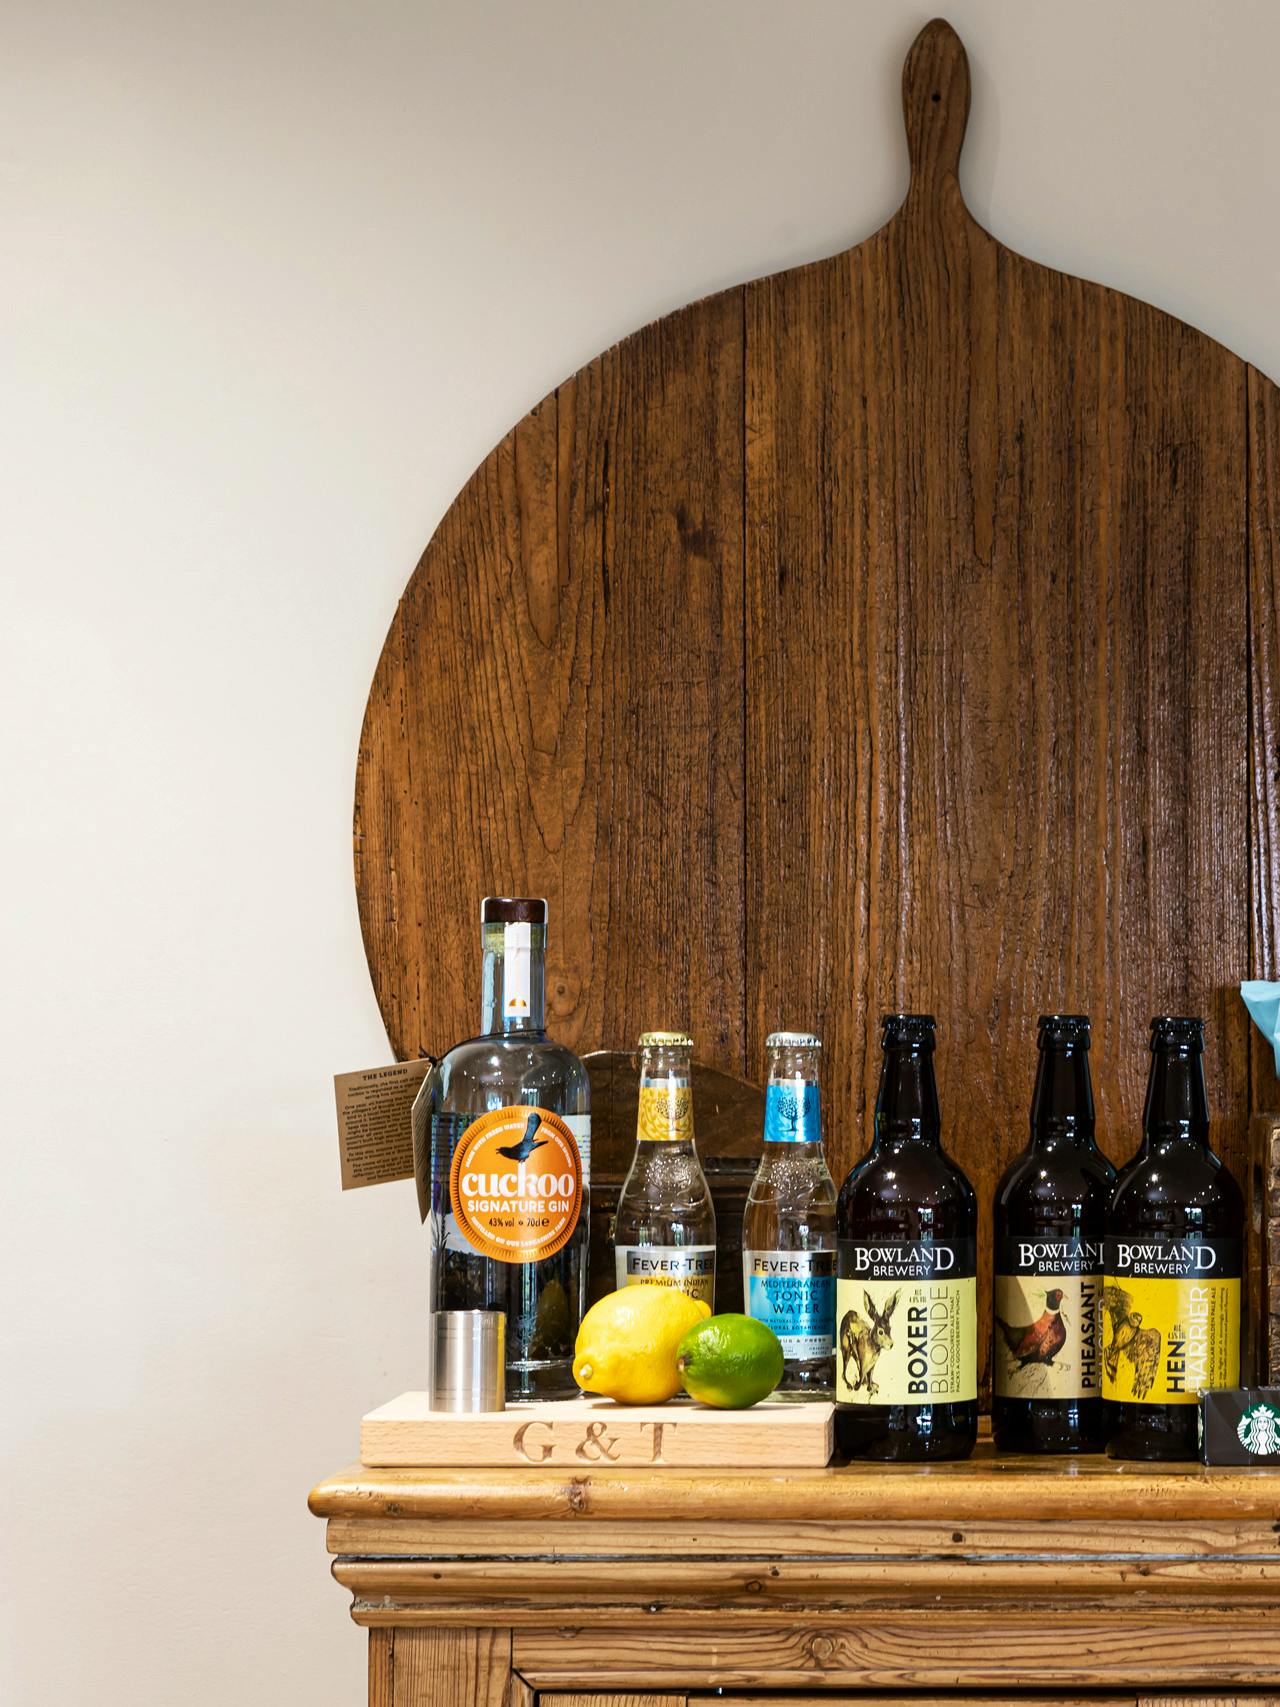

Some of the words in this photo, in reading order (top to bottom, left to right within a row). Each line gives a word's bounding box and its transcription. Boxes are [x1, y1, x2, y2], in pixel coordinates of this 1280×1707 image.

[362, 1073, 378, 1081] THE
[379, 1068, 408, 1079] LEGEND
[462, 1161, 575, 1198] cuckoo
[467, 1200, 545, 1213] SIGNATURE
[548, 1200, 569, 1213] GIN
[489, 1218, 504, 1227] 43%
[504, 1218, 515, 1227] vol
[855, 1247, 954, 1271] BOWLAND
[1117, 1244, 1216, 1270] BOWLAND
[632, 1258, 713, 1271] FEVER-TREE
[1038, 1260, 1094, 1272] BREWERY
[1133, 1262, 1191, 1274] BREWERY
[873, 1266, 931, 1277] BREWERY
[640, 1278, 681, 1287] PREMIUM
[683, 1278, 709, 1287] INDIAN
[761, 1280, 831, 1289] MEDITERRANEAN
[774, 1290, 818, 1301] TONIC
[773, 1304, 820, 1314] WATER
[930, 1286, 948, 1393] BLONDE
[1081, 1282, 1096, 1389] PHEASANT
[1188, 1286, 1209, 1393] HARRIER
[907, 1306, 928, 1394] BOXER
[1166, 1341, 1185, 1393] HEN
[513, 1421, 554, 1463] G
[575, 1421, 621, 1463] &
[640, 1422, 677, 1463] T
